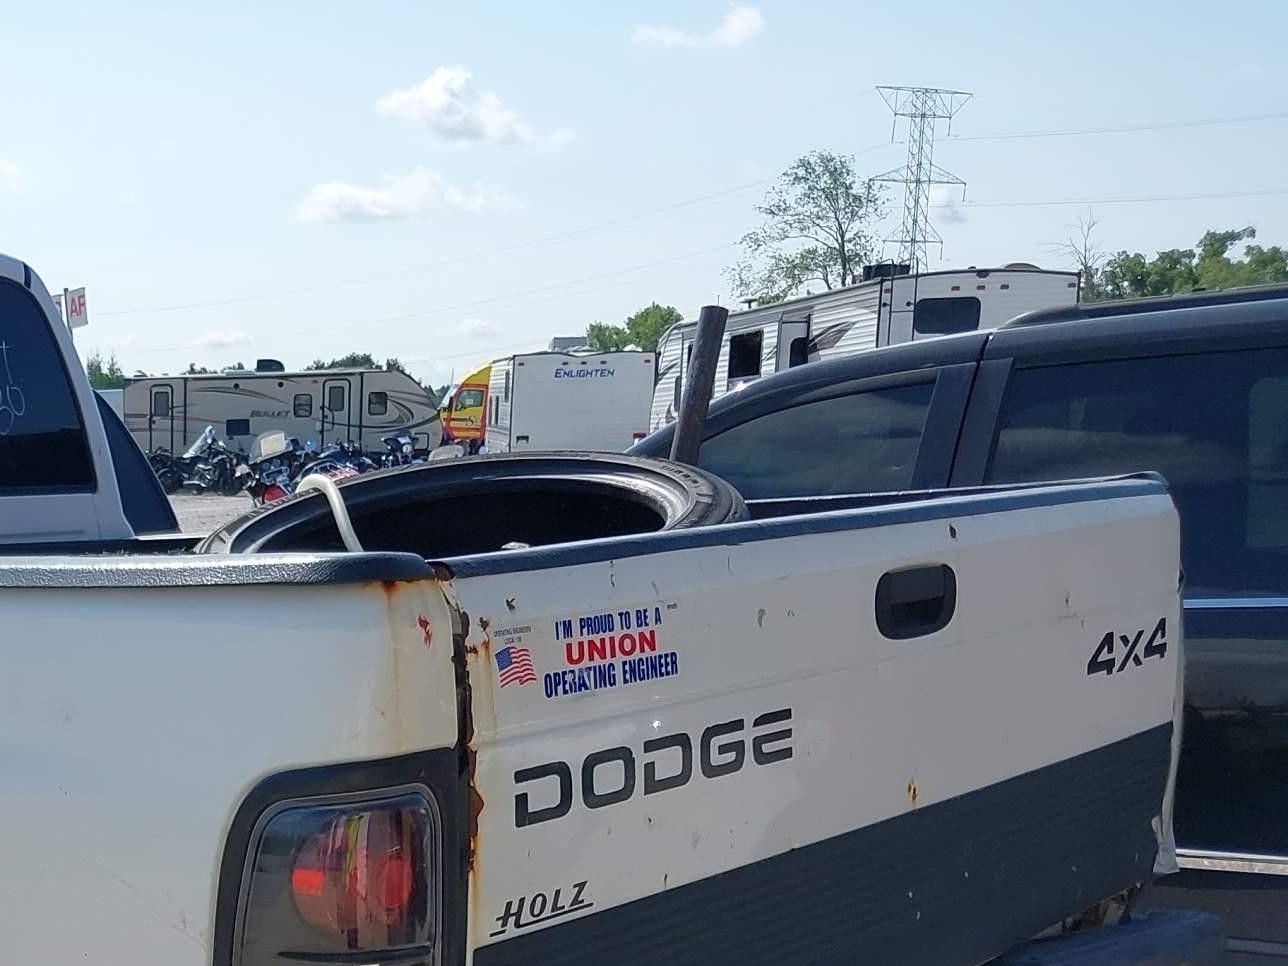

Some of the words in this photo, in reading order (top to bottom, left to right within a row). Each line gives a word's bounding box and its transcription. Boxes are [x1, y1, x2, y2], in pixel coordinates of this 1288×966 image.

[554, 368, 615, 379] ENLIGHTEN
[555, 619, 573, 641] I'M
[579, 613, 614, 637] PROUD
[618, 610, 632, 631] TO
[635, 608, 649, 629] BE
[654, 606, 662, 626] A
[565, 629, 657, 666] UNION
[543, 662, 617, 699] OPERATING
[622, 651, 679, 685] ENGINEER
[513, 707, 794, 829] DODGE
[494, 880, 594, 931] HOLZ
